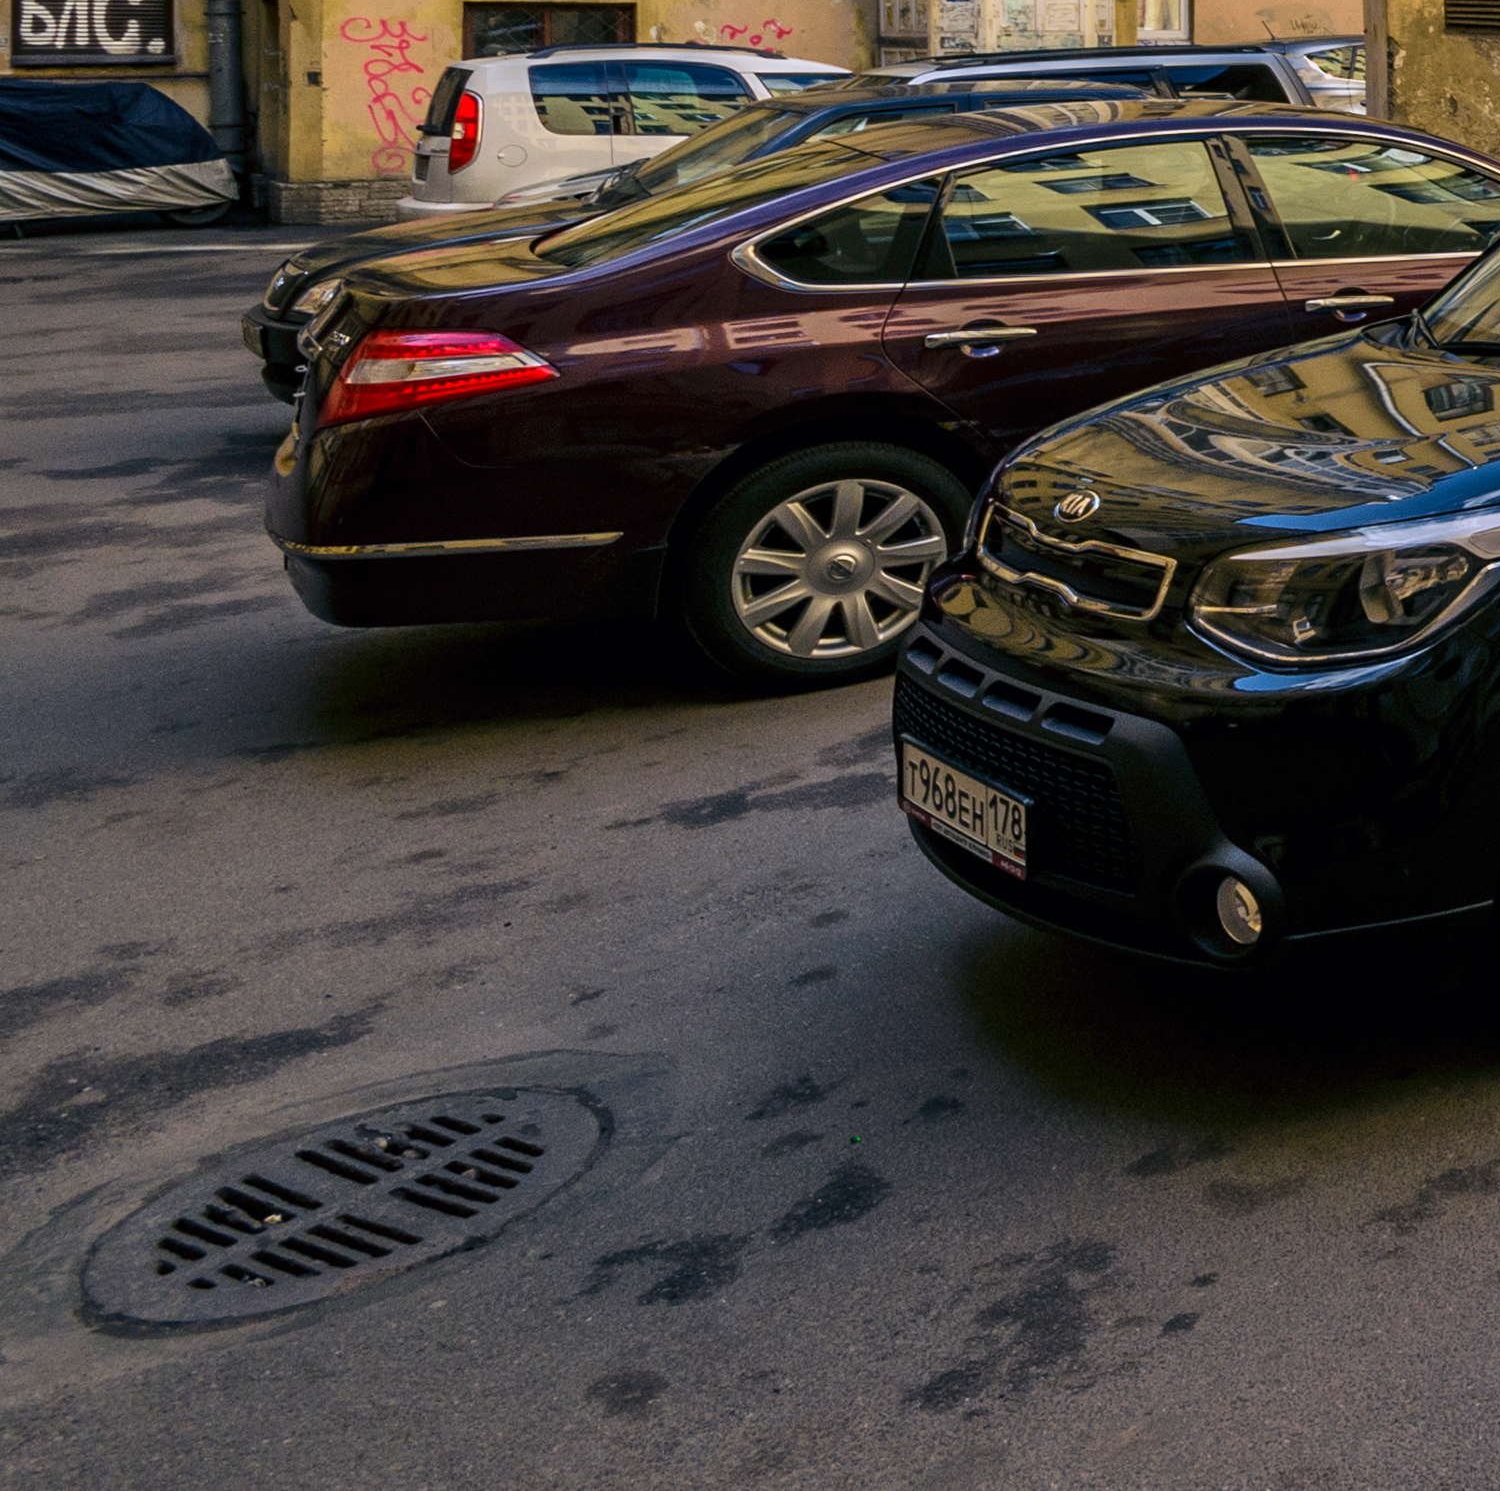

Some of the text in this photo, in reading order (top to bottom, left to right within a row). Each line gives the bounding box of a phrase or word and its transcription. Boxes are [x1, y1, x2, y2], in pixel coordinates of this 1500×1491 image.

[1060, 493, 1092, 518] KIA
[908, 758, 985, 838] Т968ЕН
[988, 794, 1023, 842] 178
[996, 833, 1014, 854] RUS
